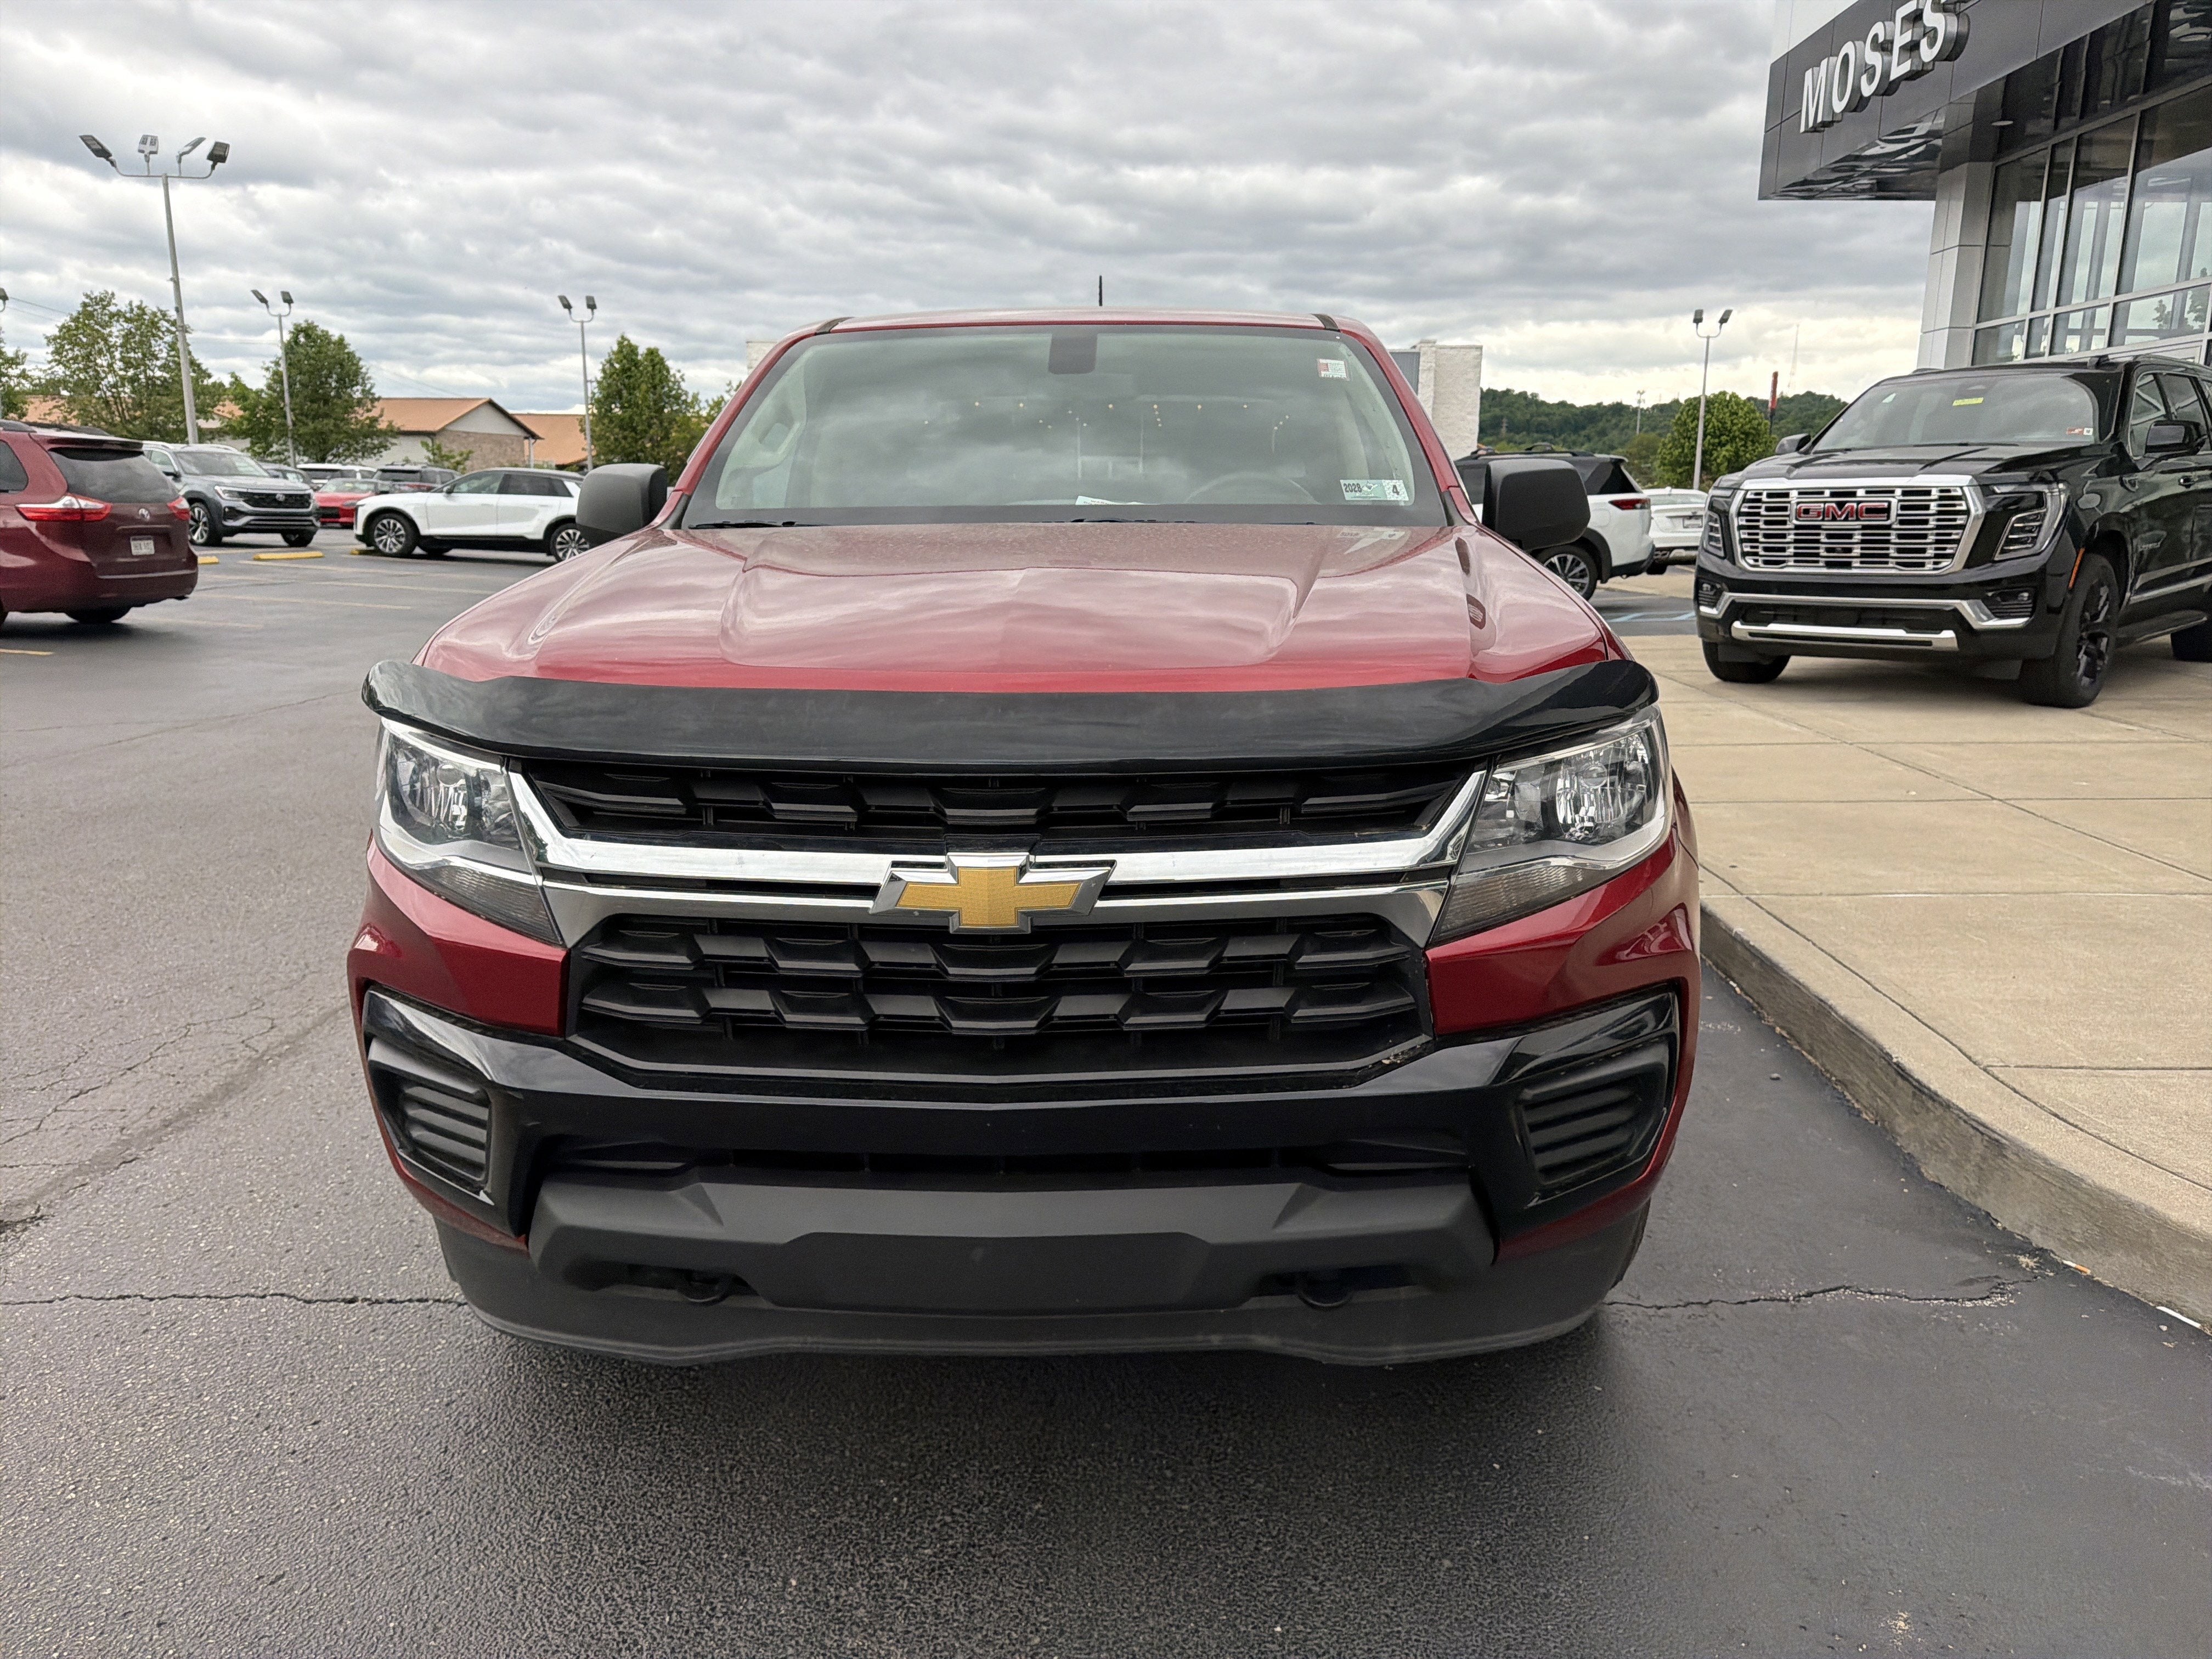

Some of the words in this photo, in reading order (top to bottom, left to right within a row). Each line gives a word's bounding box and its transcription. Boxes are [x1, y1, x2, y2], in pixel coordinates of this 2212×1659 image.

[1800, 0, 1951, 133] MOSES
[1343, 483, 1362, 493] 2028
[1392, 484, 1400, 495] 4
[1797, 502, 1888, 521] GMC
